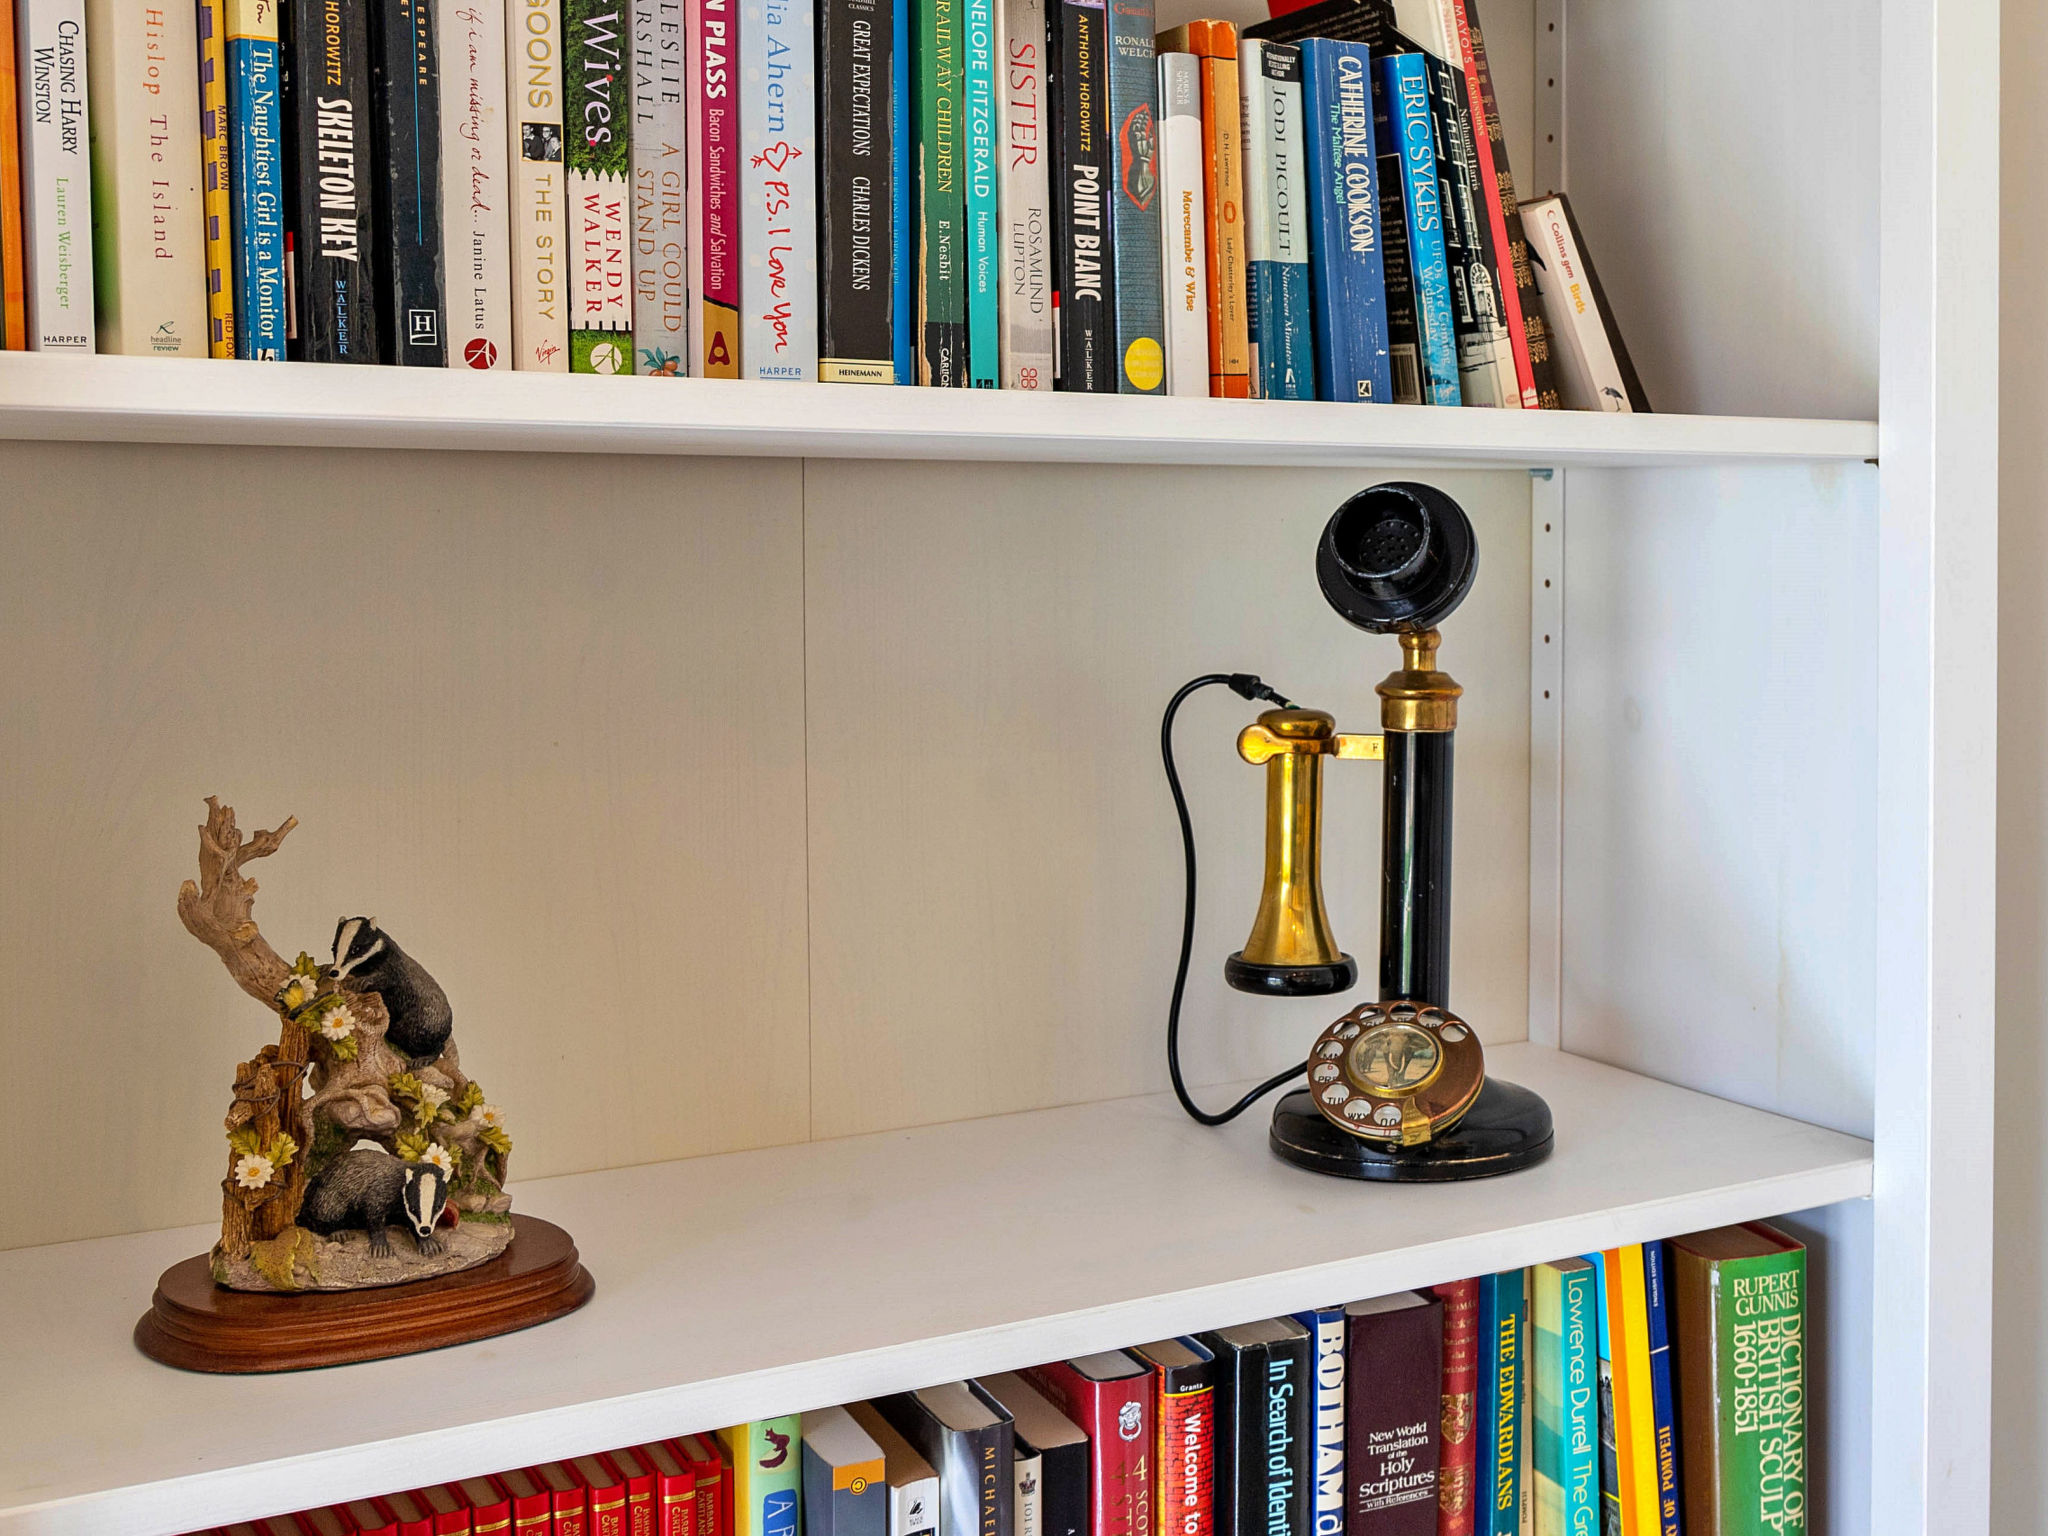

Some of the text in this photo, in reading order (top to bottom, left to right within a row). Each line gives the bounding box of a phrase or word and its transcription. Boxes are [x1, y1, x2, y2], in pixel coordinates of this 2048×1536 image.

[456, 8, 484, 24] if
[852, 20, 871, 62] GREAT
[1454, 5, 1472, 63] MAYO'S
[34, 47, 55, 124] WINSTON
[57, 20, 82, 156] CHASING HARRY
[253, 48, 274, 84] The
[468, 44, 479, 73] am
[583, 10, 621, 146] Wives
[705, 21, 727, 99] PLASS
[767, 35, 792, 134] Ahern
[143, 8, 173, 260] Hislop The Island
[318, 1, 358, 262] HOROWITZ SKELETON KEY
[460, 78, 485, 142] missing
[708, 108, 724, 142] Bacon
[852, 64, 871, 156] EXPECTATIONS
[1009, 38, 1038, 172] SISTER
[1272, 86, 1288, 145] JODI
[218, 105, 229, 191] MARC BROWN
[250, 90, 277, 186] Naughtiest
[636, 0, 656, 303] RSHALL STAND UP
[660, 3, 682, 333] LESLIE A GIRL COULD
[936, 97, 953, 194] CHILDREN
[972, 80, 990, 198] FITZGERALD
[1073, 14, 1102, 302] ANTHONY HOROWITZ POINT BLANC
[1330, 103, 1346, 206] The Maltese Angel
[1337, 56, 1375, 254] CATHERINE COOKSON
[1401, 75, 1441, 233] ERIC SYKES
[1459, 108, 1480, 191] Nathaniel Harris
[256, 191, 279, 228] Girl
[535, 175, 552, 223] THE
[709, 146, 725, 211] Sandwiches
[852, 176, 871, 234] CHARLES
[1274, 155, 1294, 257] PICOULT
[56, 177, 72, 310] Lauren Weisberger
[258, 231, 278, 246] is
[259, 250, 273, 260] a
[473, 230, 486, 281] Janine
[584, 193, 603, 313] WALKER
[604, 201, 624, 308] WENDY
[710, 213, 724, 236] and
[767, 227, 791, 236] I
[977, 211, 987, 254] Human
[1182, 190, 1195, 312] Morecambe & Wise
[1226, 237, 1235, 251] Lady
[536, 236, 555, 321] STORY
[709, 236, 726, 290] Salvation
[852, 236, 871, 291] DICKENS
[977, 256, 988, 294] Voices
[1012, 223, 1026, 296] LUPTON
[1027, 207, 1044, 314] ROSAMUND
[1431, 240, 1444, 279] UFOs
[1551, 222, 1586, 315] Collins gem Birds
[259, 265, 279, 340] Monitor
[335, 281, 348, 354] WALKER
[475, 287, 485, 330] Latus
[763, 300, 792, 354] You
[1282, 265, 1293, 366] Nineteen Minutes
[1423, 265, 1439, 341] Wednesday
[1435, 283, 1447, 308] Are
[44, 335, 87, 344] HARPER
[150, 335, 182, 344] headline
[225, 312, 235, 357] RED FOX
[1085, 329, 1094, 391] WALKER
[759, 366, 801, 376] HARPER
[838, 368, 883, 378] HEINEMANN
[1734, 1270, 1799, 1298] RUPERT
[1736, 1291, 1799, 1316] GUNNIS
[1499, 1313, 1516, 1362] THE
[1180, 1382, 1204, 1392] Granta
[1269, 1358, 1293, 1381] In
[1568, 1277, 1592, 1504] Lawrence Durrell The
[1734, 1324, 1758, 1436] 1660-1851
[1758, 1318, 1783, 1432] BRITISH
[1269, 1382, 1293, 1454] Search
[1317, 1320, 1345, 1511] BOTHAM
[1367, 1433, 1429, 1457] Translation
[1369, 1421, 1428, 1444] New World
[1497, 1363, 1515, 1511] EDWARDIANS
[1780, 1312, 1805, 1528] DICTIONARY OF
[1132, 1454, 1148, 1481] 4
[1184, 1412, 1202, 1534] Welcome to
[1268, 1455, 1293, 1477] of
[1359, 1469, 1436, 1498] Scriptures
[1380, 1456, 1416, 1478] Holy
[1387, 1449, 1408, 1460] of the
[1659, 1426, 1676, 1518] OF POMPEII
[705, 1492, 714, 1534] BARBARA
[1366, 1488, 1429, 1510] With References
